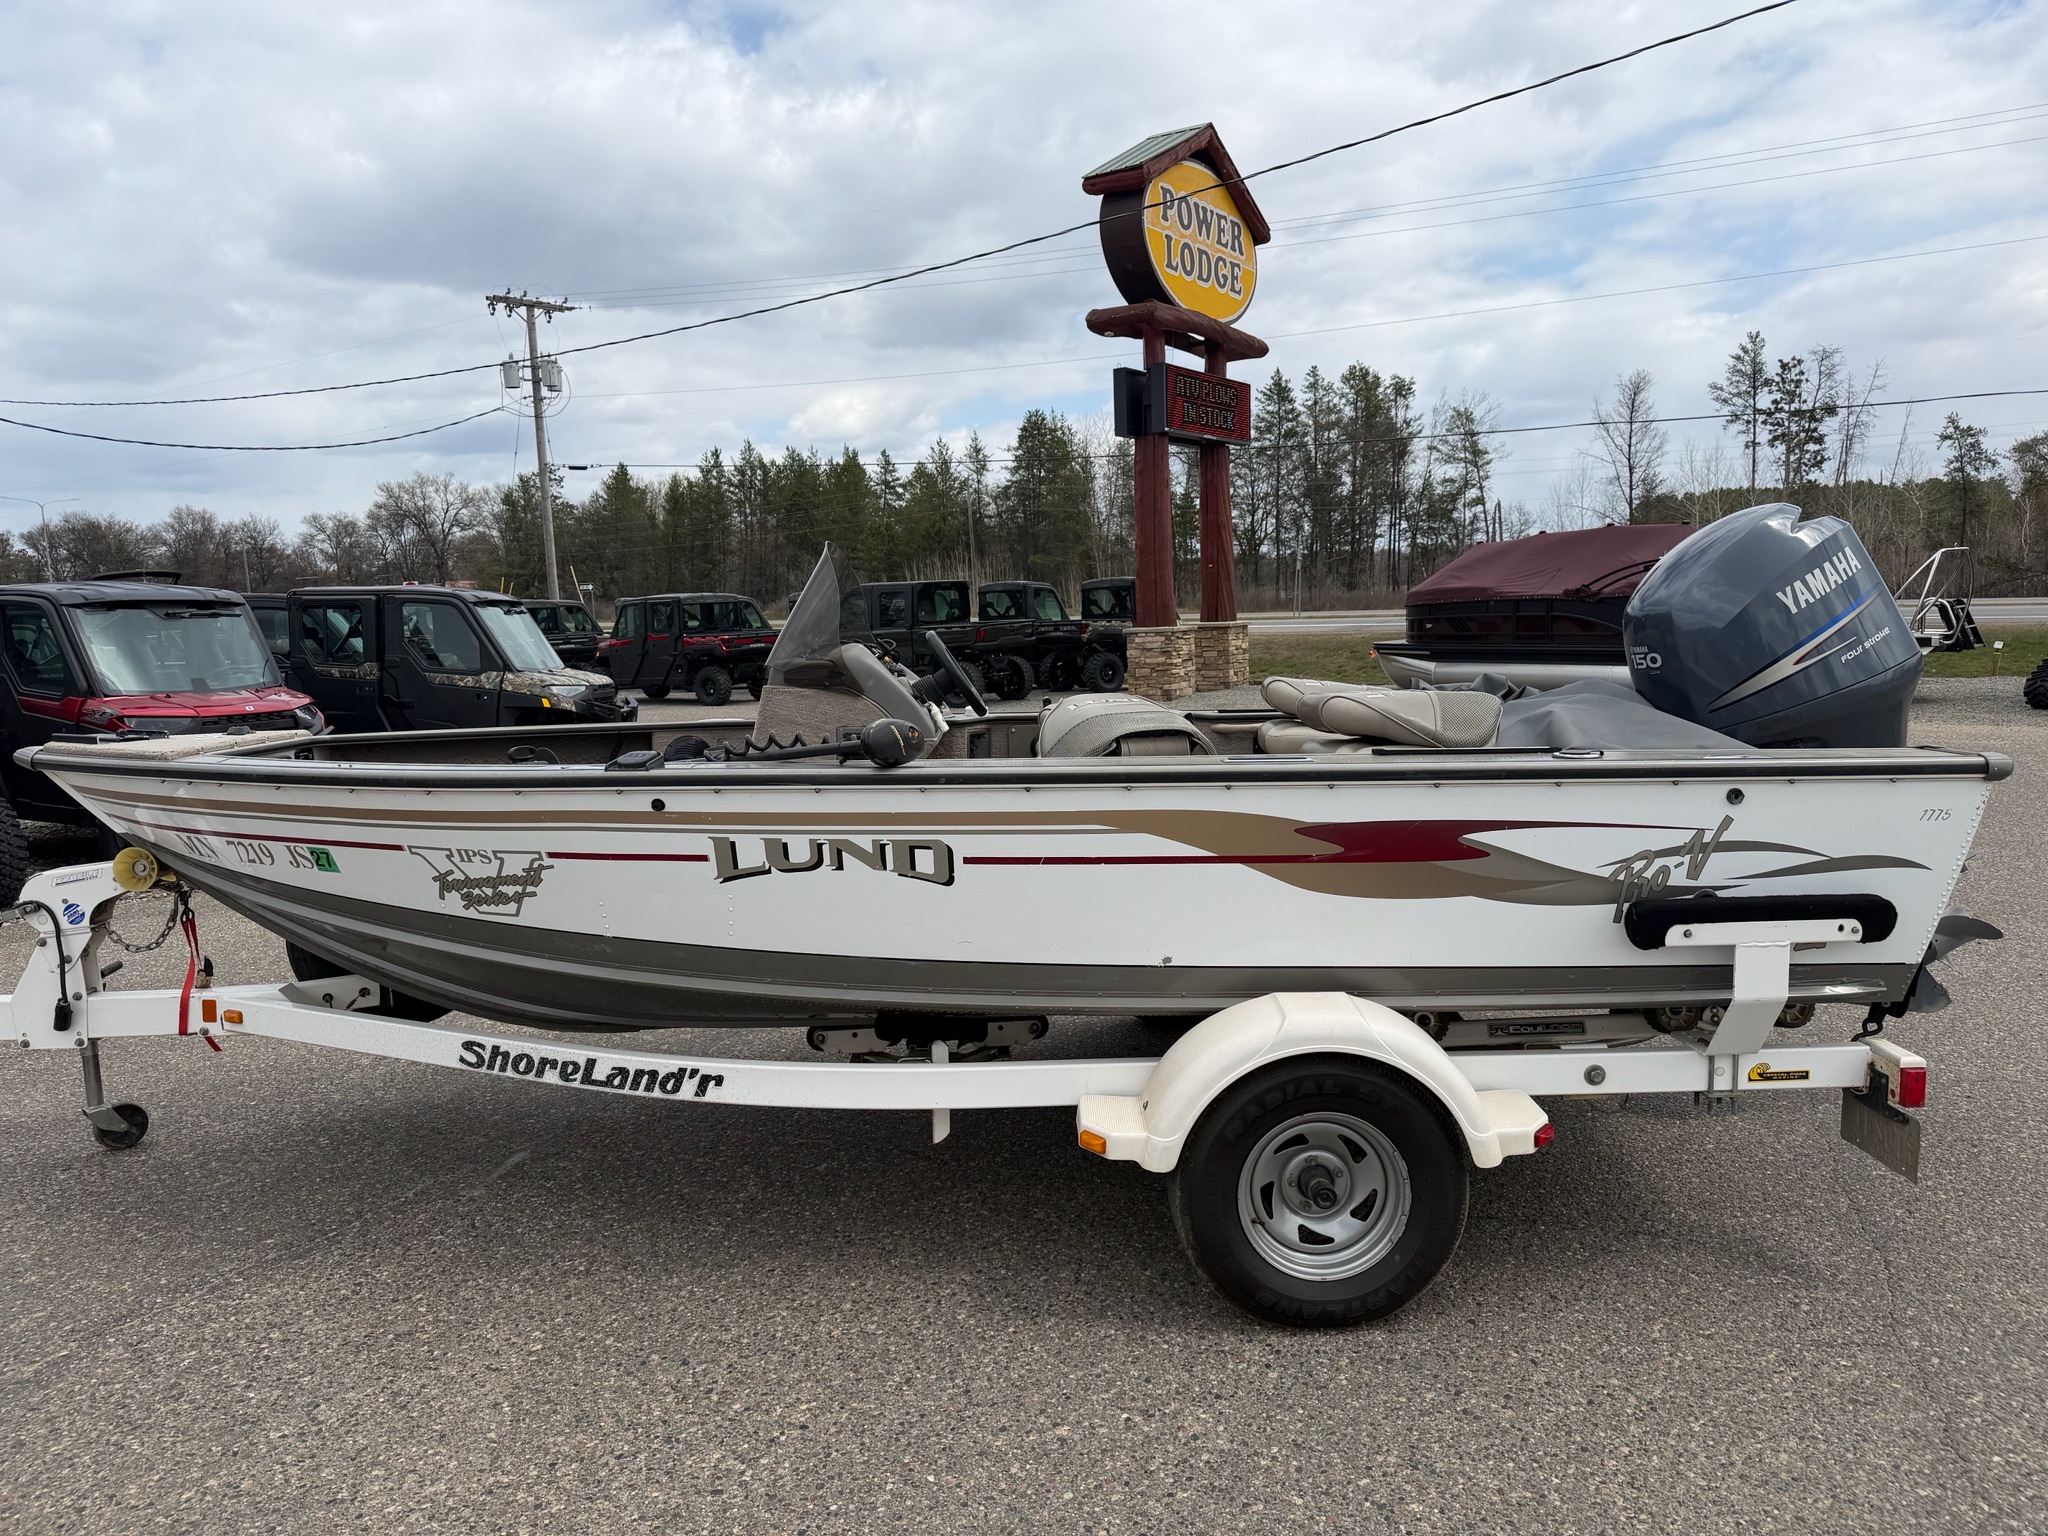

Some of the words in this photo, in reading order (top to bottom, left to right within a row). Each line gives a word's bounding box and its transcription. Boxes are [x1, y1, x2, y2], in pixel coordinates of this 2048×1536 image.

[1159, 184, 1245, 257] POWER
[1164, 233, 1243, 297] LODGE
[1200, 406, 1234, 430] STOCK
[1775, 546, 1862, 615] YAMAHA
[1631, 653, 1662, 669] 150
[1919, 808, 1954, 822] 1775
[175, 833, 221, 860] MN
[225, 839, 275, 866] 7219
[283, 844, 315, 870] JS
[310, 850, 334, 869] 27
[456, 848, 493, 864] IPS
[708, 836, 955, 887] LUND
[432, 863, 555, 900] Tournament
[461, 890, 538, 911] Series
[458, 1039, 725, 1098] ShoreLand'r
